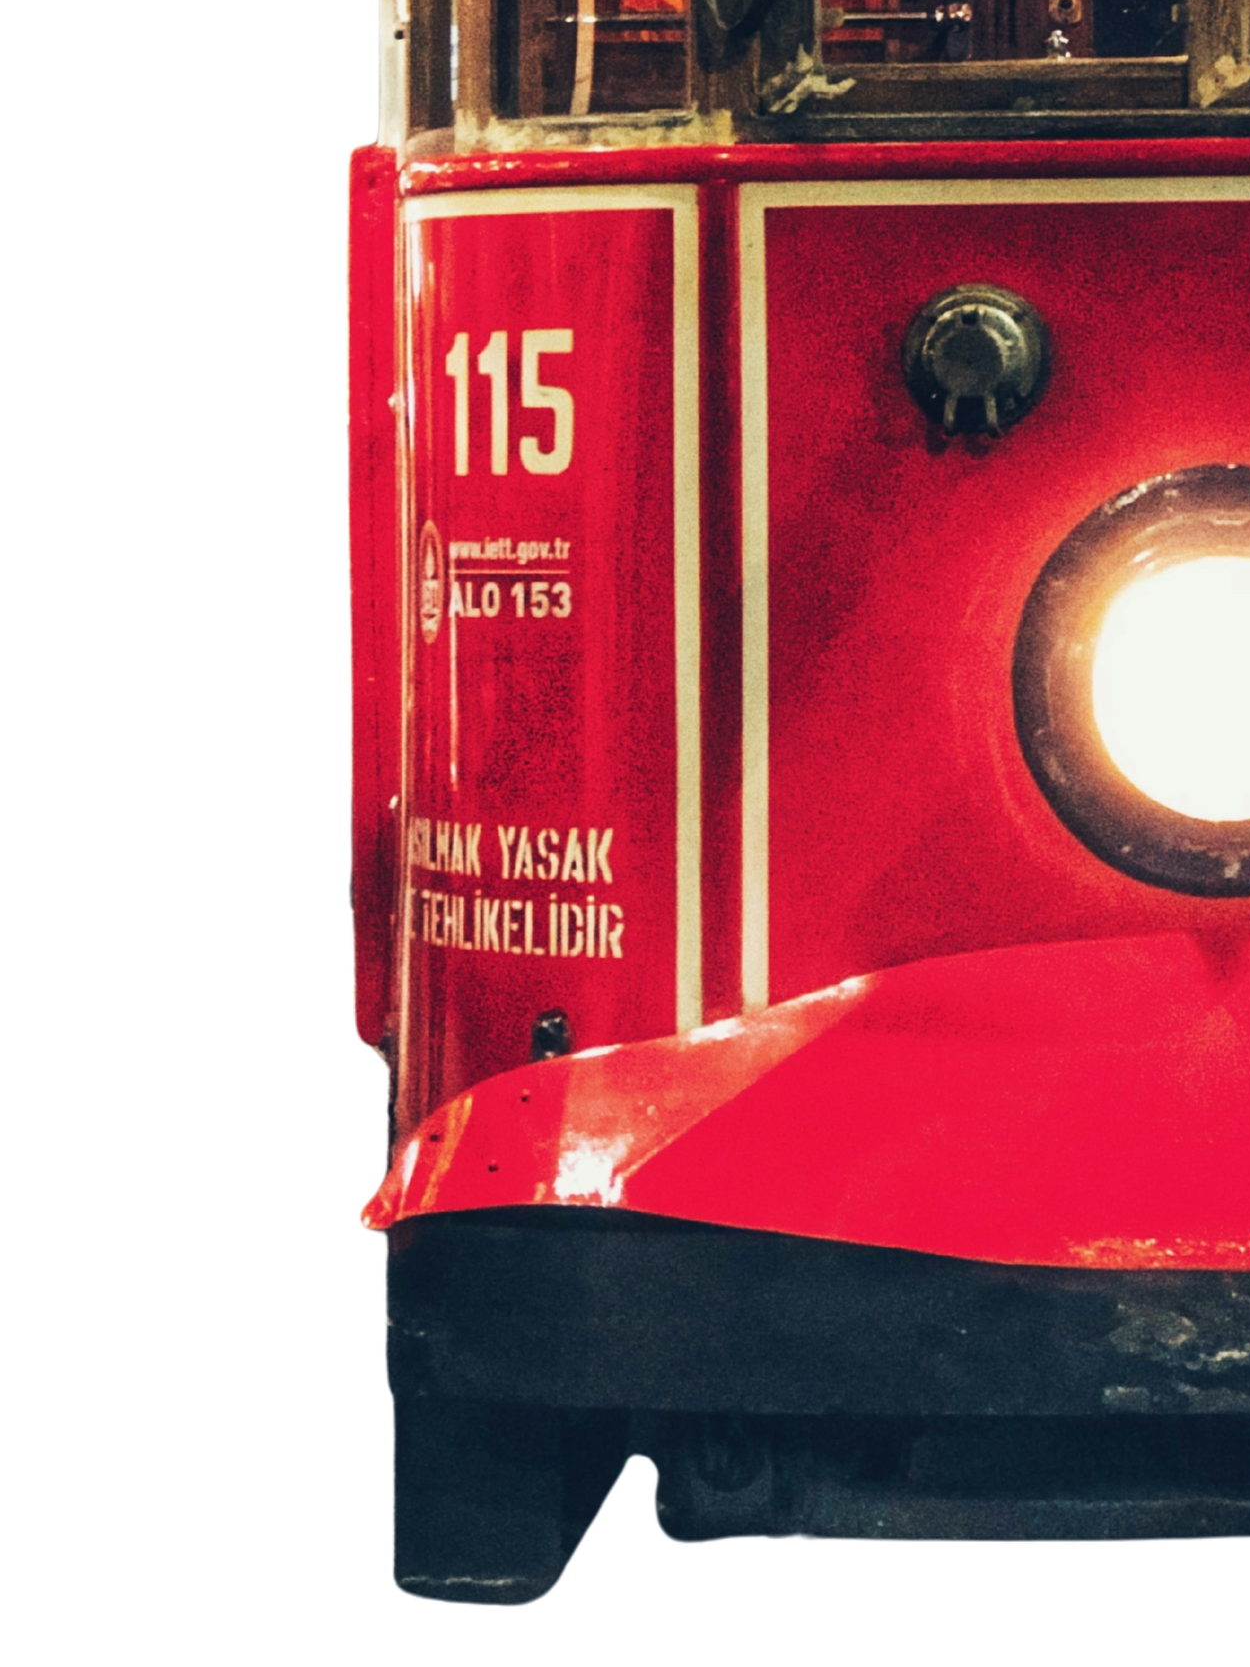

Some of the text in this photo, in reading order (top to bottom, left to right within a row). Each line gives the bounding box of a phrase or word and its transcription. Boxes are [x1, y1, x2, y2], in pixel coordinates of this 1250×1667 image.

[445, 329, 574, 477] 115
[449, 537, 571, 565] www.iett.gov.tr
[511, 582, 572, 618] 153
[497, 824, 614, 884] YASAK
